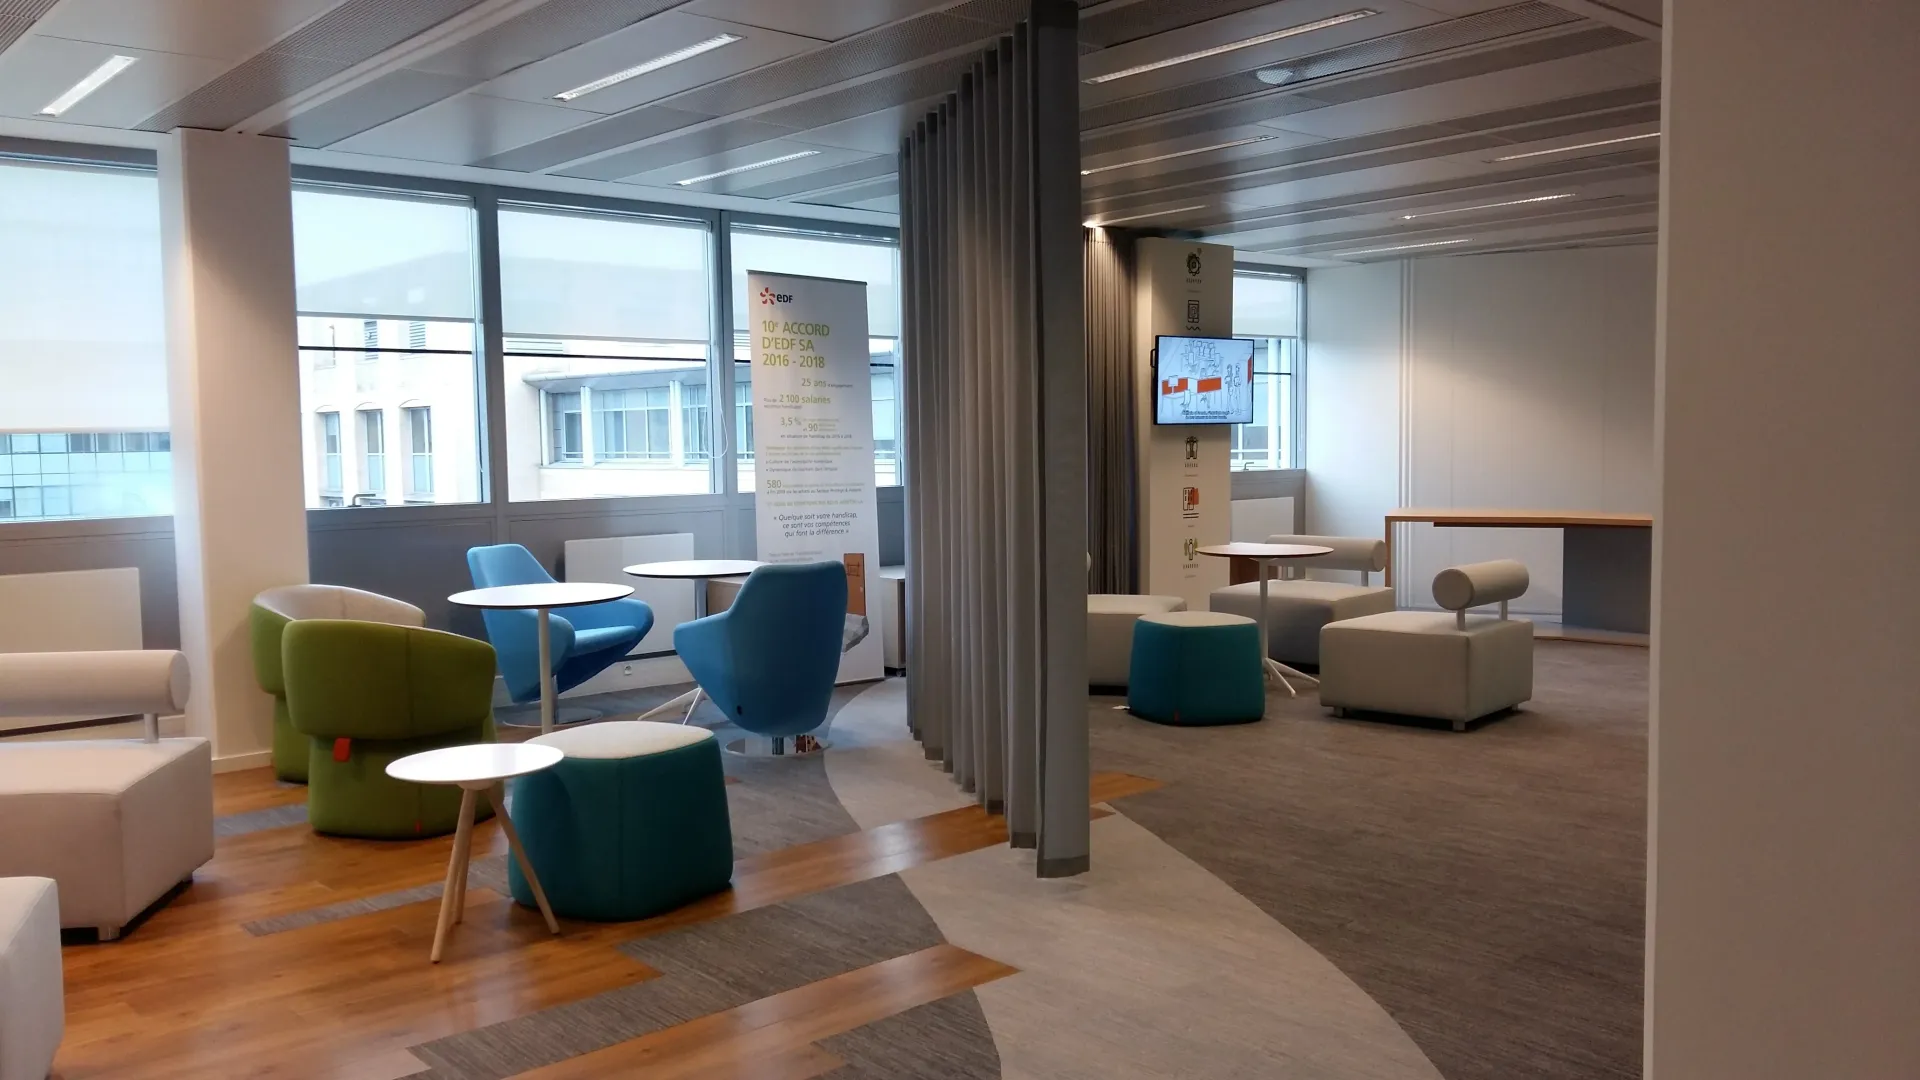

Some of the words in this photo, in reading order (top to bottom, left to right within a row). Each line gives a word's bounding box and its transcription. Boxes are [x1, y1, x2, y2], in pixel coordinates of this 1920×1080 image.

[783, 322, 830, 336] ACCORD
[762, 337, 796, 350] D'EDF
[799, 339, 814, 352] SA
[762, 354, 789, 366] 2016
[800, 356, 825, 368] 2018
[801, 378, 811, 387] 25
[814, 380, 827, 388] ans
[779, 394, 784, 403] 2
[786, 394, 800, 404] 100
[781, 417, 792, 427] 3,5
[808, 423, 818, 432] 90
[766, 480, 781, 489] 580
